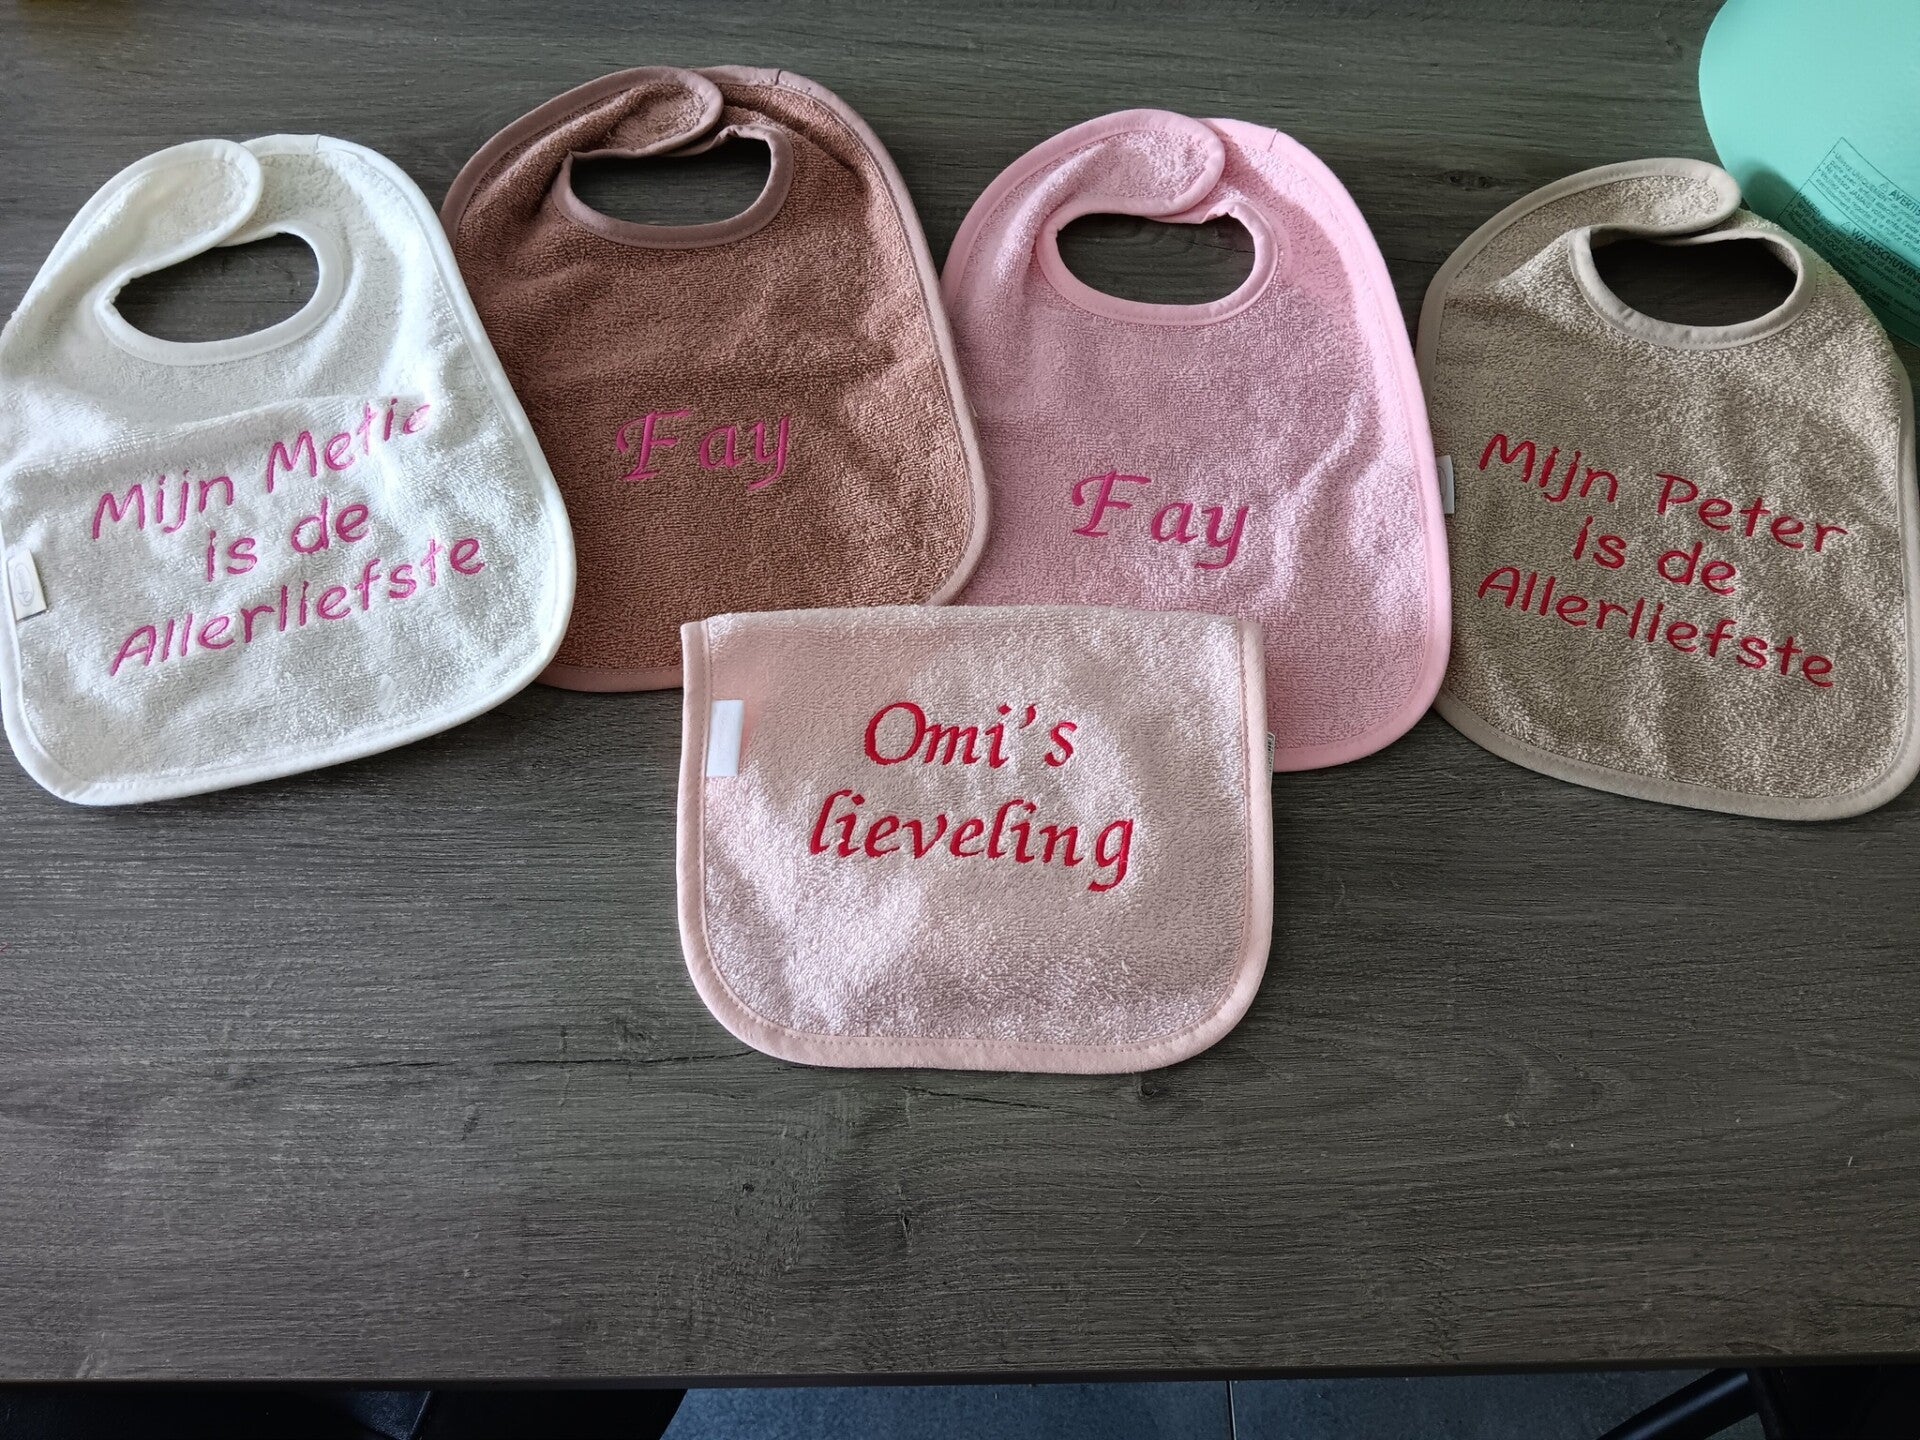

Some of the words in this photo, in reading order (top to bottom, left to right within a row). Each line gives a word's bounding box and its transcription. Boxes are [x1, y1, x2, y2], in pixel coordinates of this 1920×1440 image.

[616, 409, 790, 490] Fay
[1479, 434, 1618, 502] Mijn
[1658, 474, 1846, 552] Peter
[92, 476, 234, 539] Mijn
[208, 532, 257, 581] is
[291, 498, 368, 554] de
[1072, 470, 1248, 570] Fay
[1574, 516, 1626, 569] is
[1658, 543, 1736, 595] de
[111, 539, 484, 675] Allerliefste
[1478, 567, 1833, 688] Allerliefste
[864, 701, 1077, 769] Omi's
[809, 789, 1134, 893] lieveling
